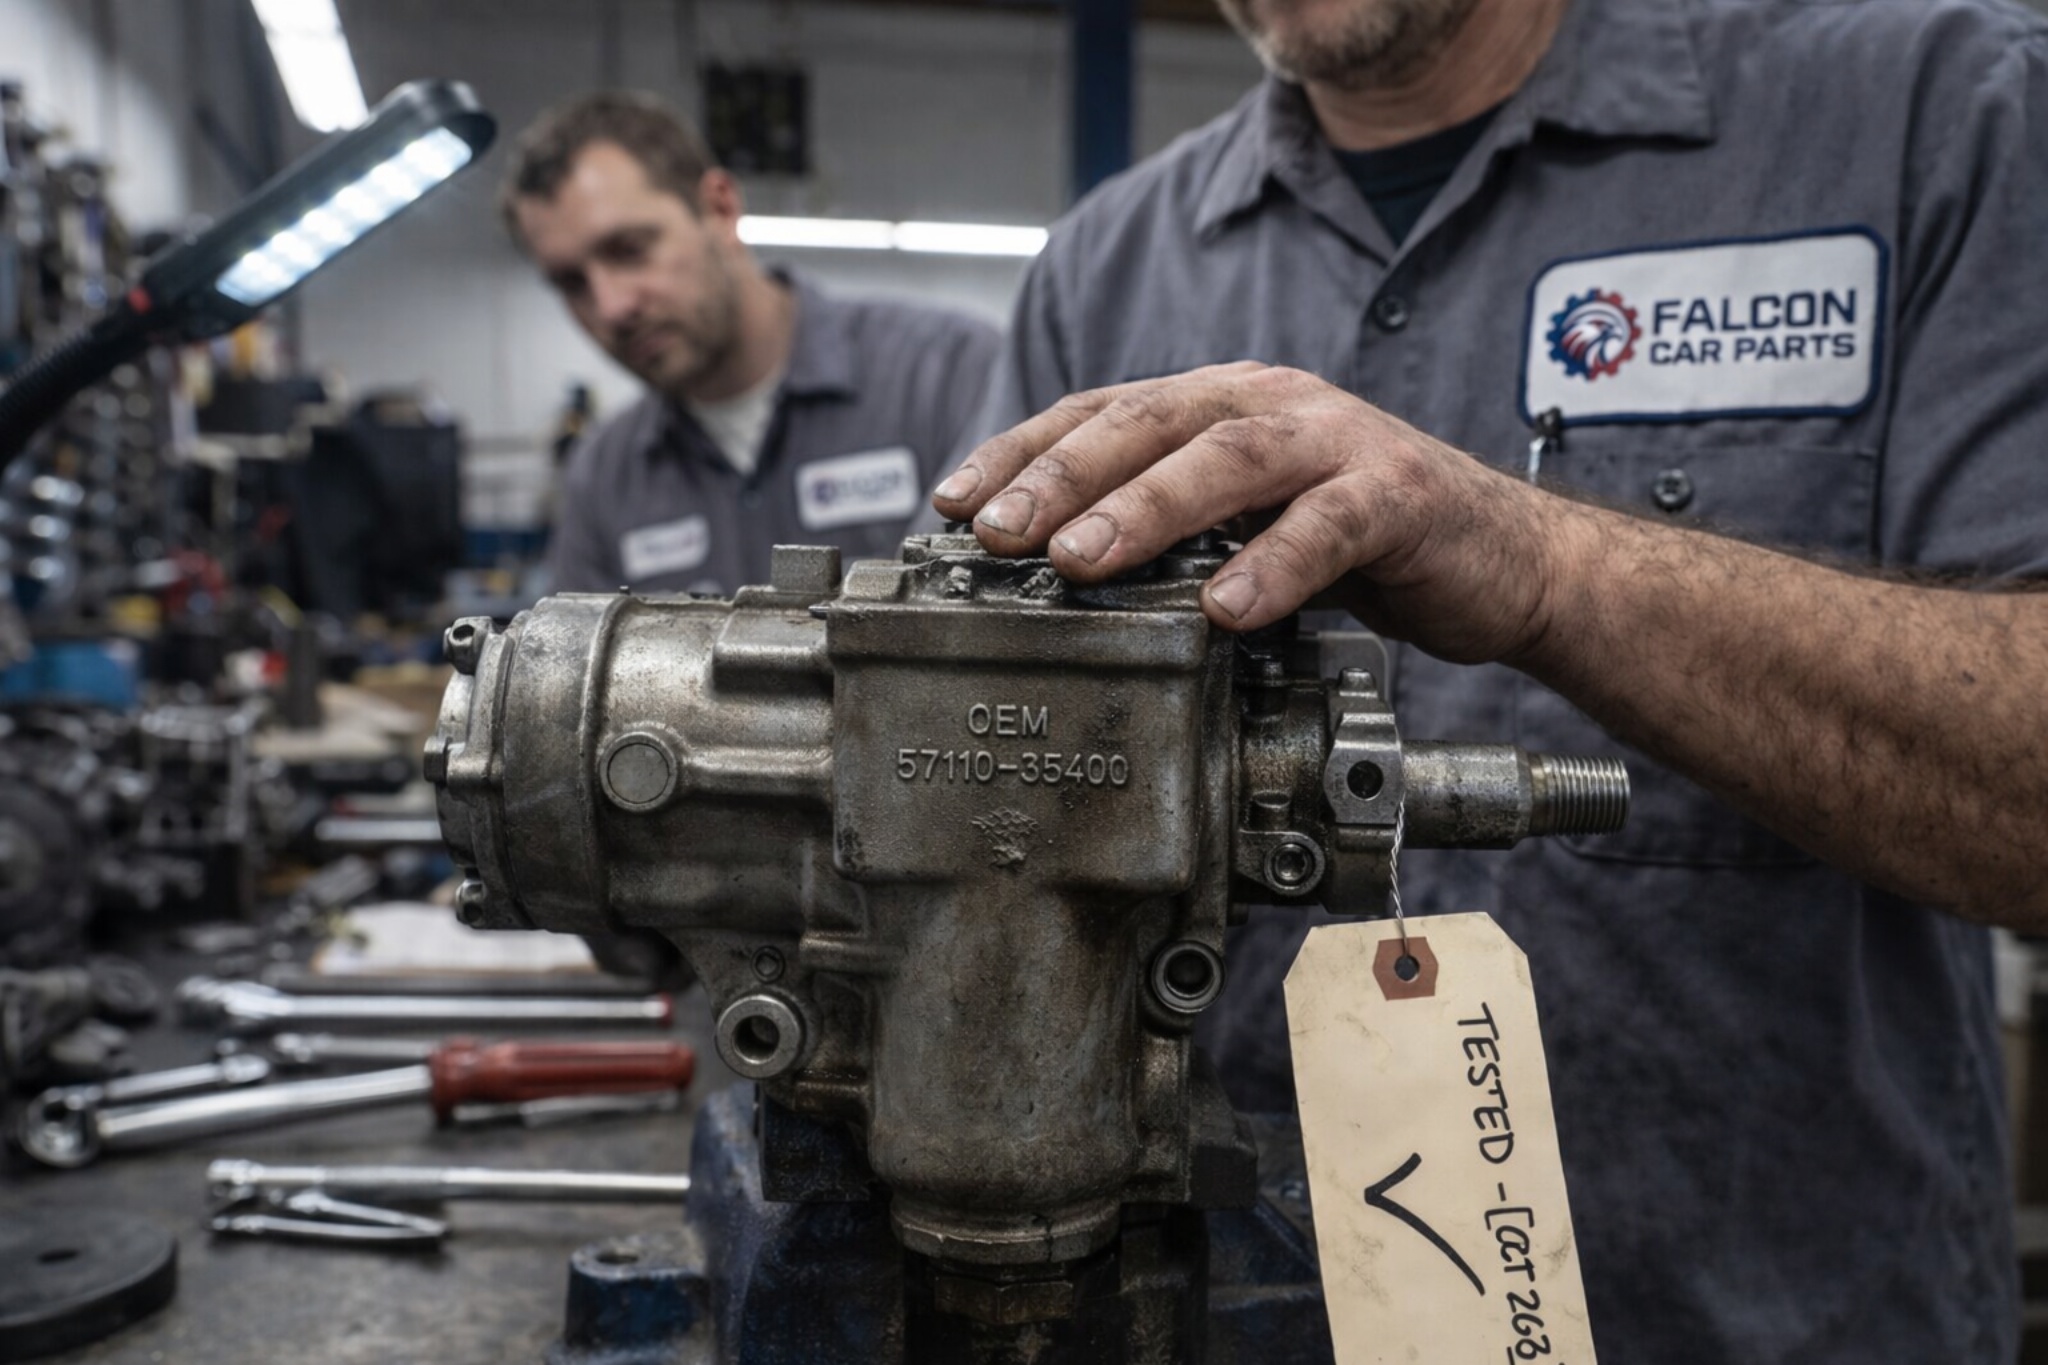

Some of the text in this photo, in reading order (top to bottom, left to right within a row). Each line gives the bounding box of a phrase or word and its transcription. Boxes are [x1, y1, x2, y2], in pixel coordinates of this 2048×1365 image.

[1652, 288, 1857, 336] FALCON
[1650, 332, 1856, 365] CAR PARTS
[967, 703, 1049, 737] OEM
[898, 748, 1129, 785] 57110-35400
[1457, 1002, 1515, 1165] TESTED
